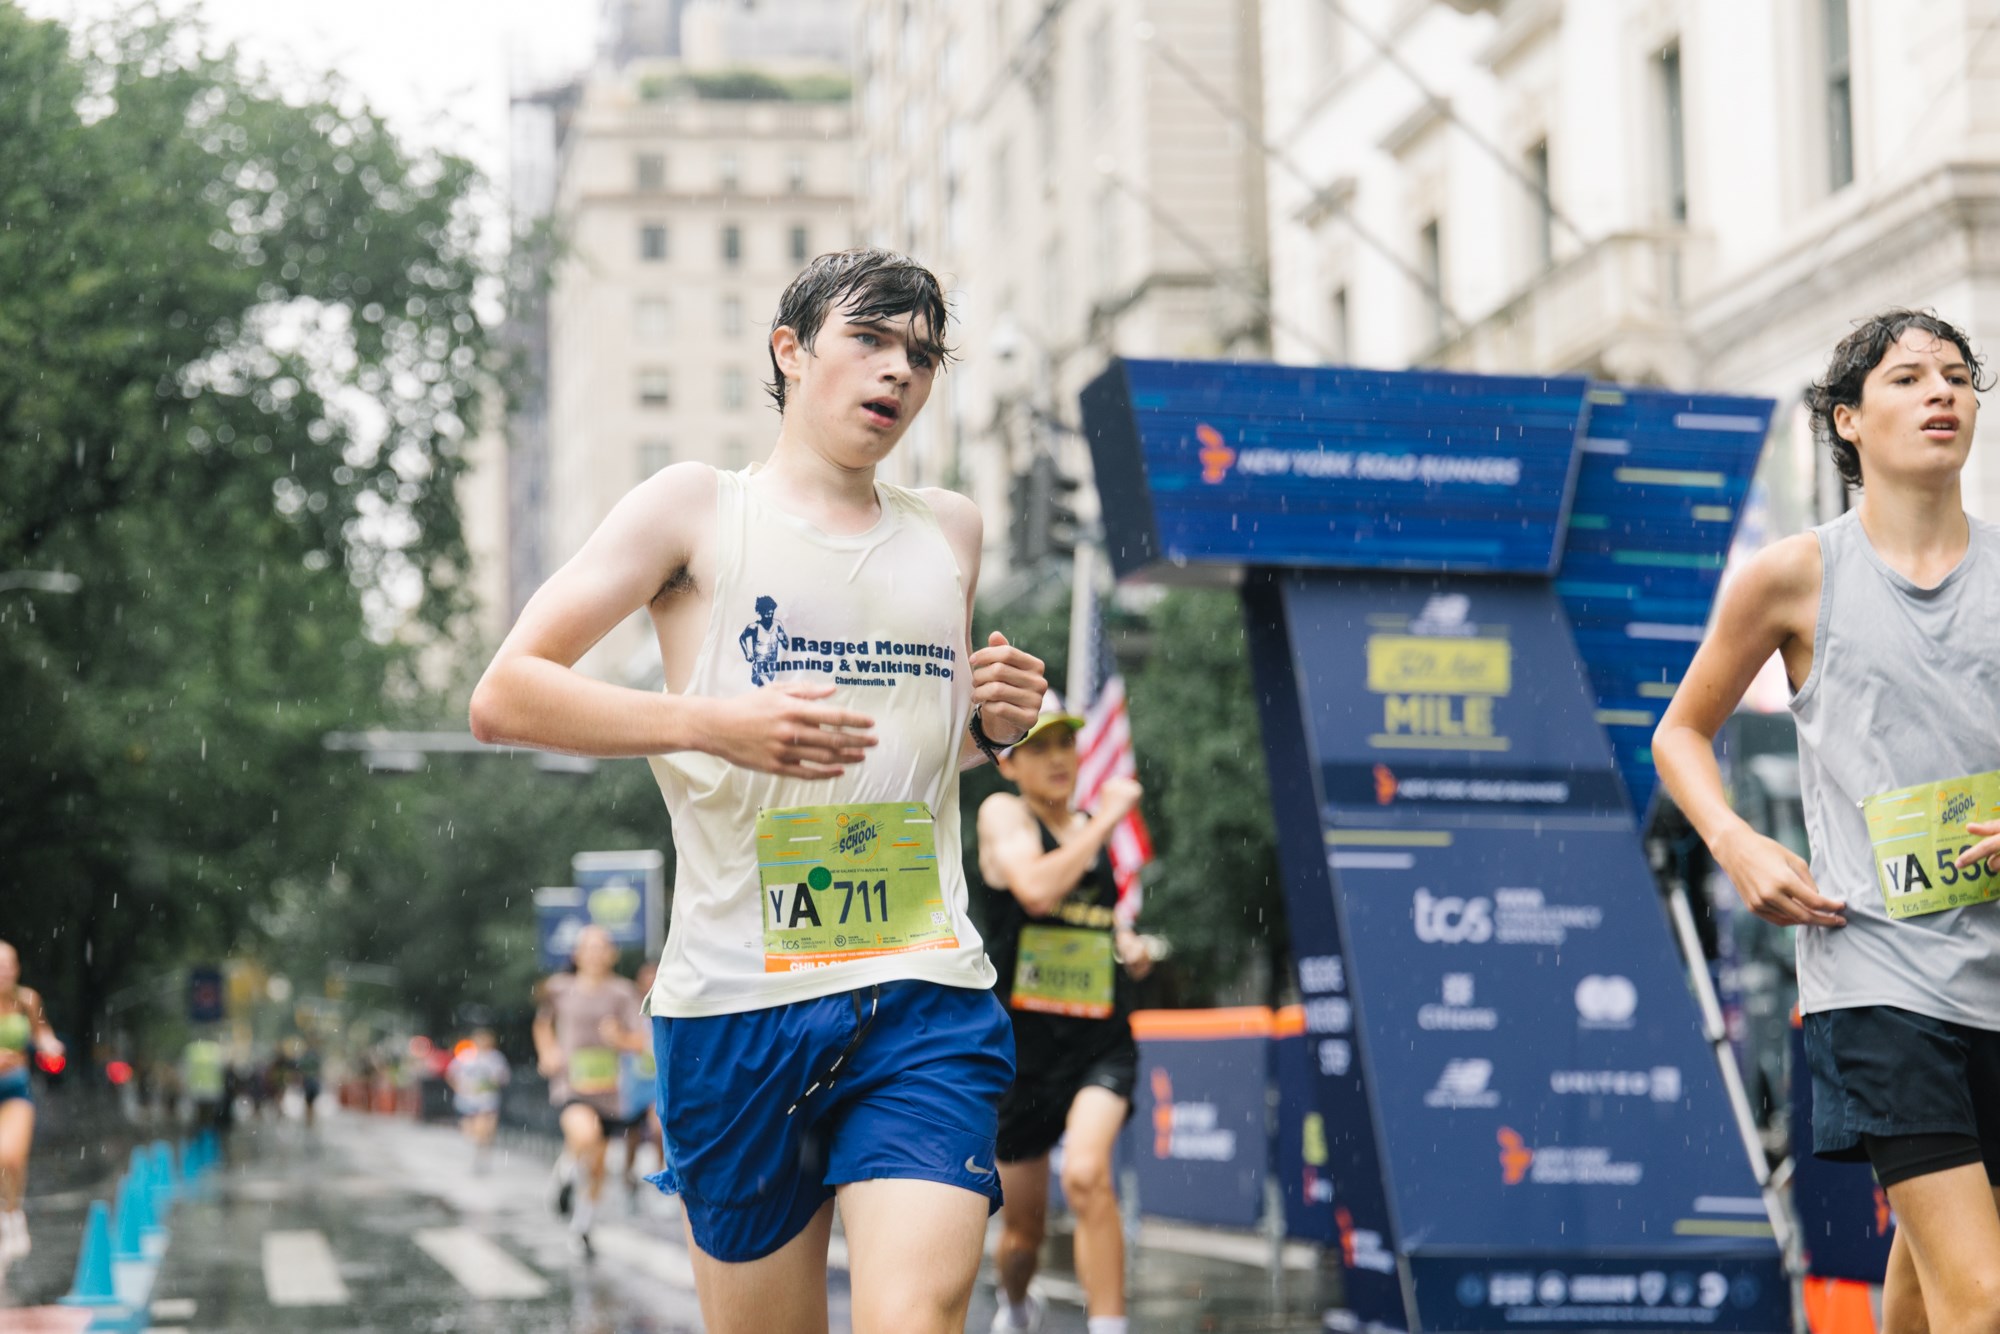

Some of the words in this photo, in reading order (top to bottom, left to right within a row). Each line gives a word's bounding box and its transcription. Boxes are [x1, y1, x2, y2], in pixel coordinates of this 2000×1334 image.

[791, 637, 868, 656] Ragged
[875, 641, 955, 662] Mountain
[757, 658, 833, 673] Running
[839, 659, 851, 672] &
[855, 660, 921, 676] Walking
[887, 678, 896, 687] VA
[1384, 695, 1494, 737] MILE
[1942, 795, 1975, 824] SCHOOL
[839, 824, 877, 854] SCHOOL
[833, 879, 888, 924] 711
[1413, 886, 1492, 944] tcs
